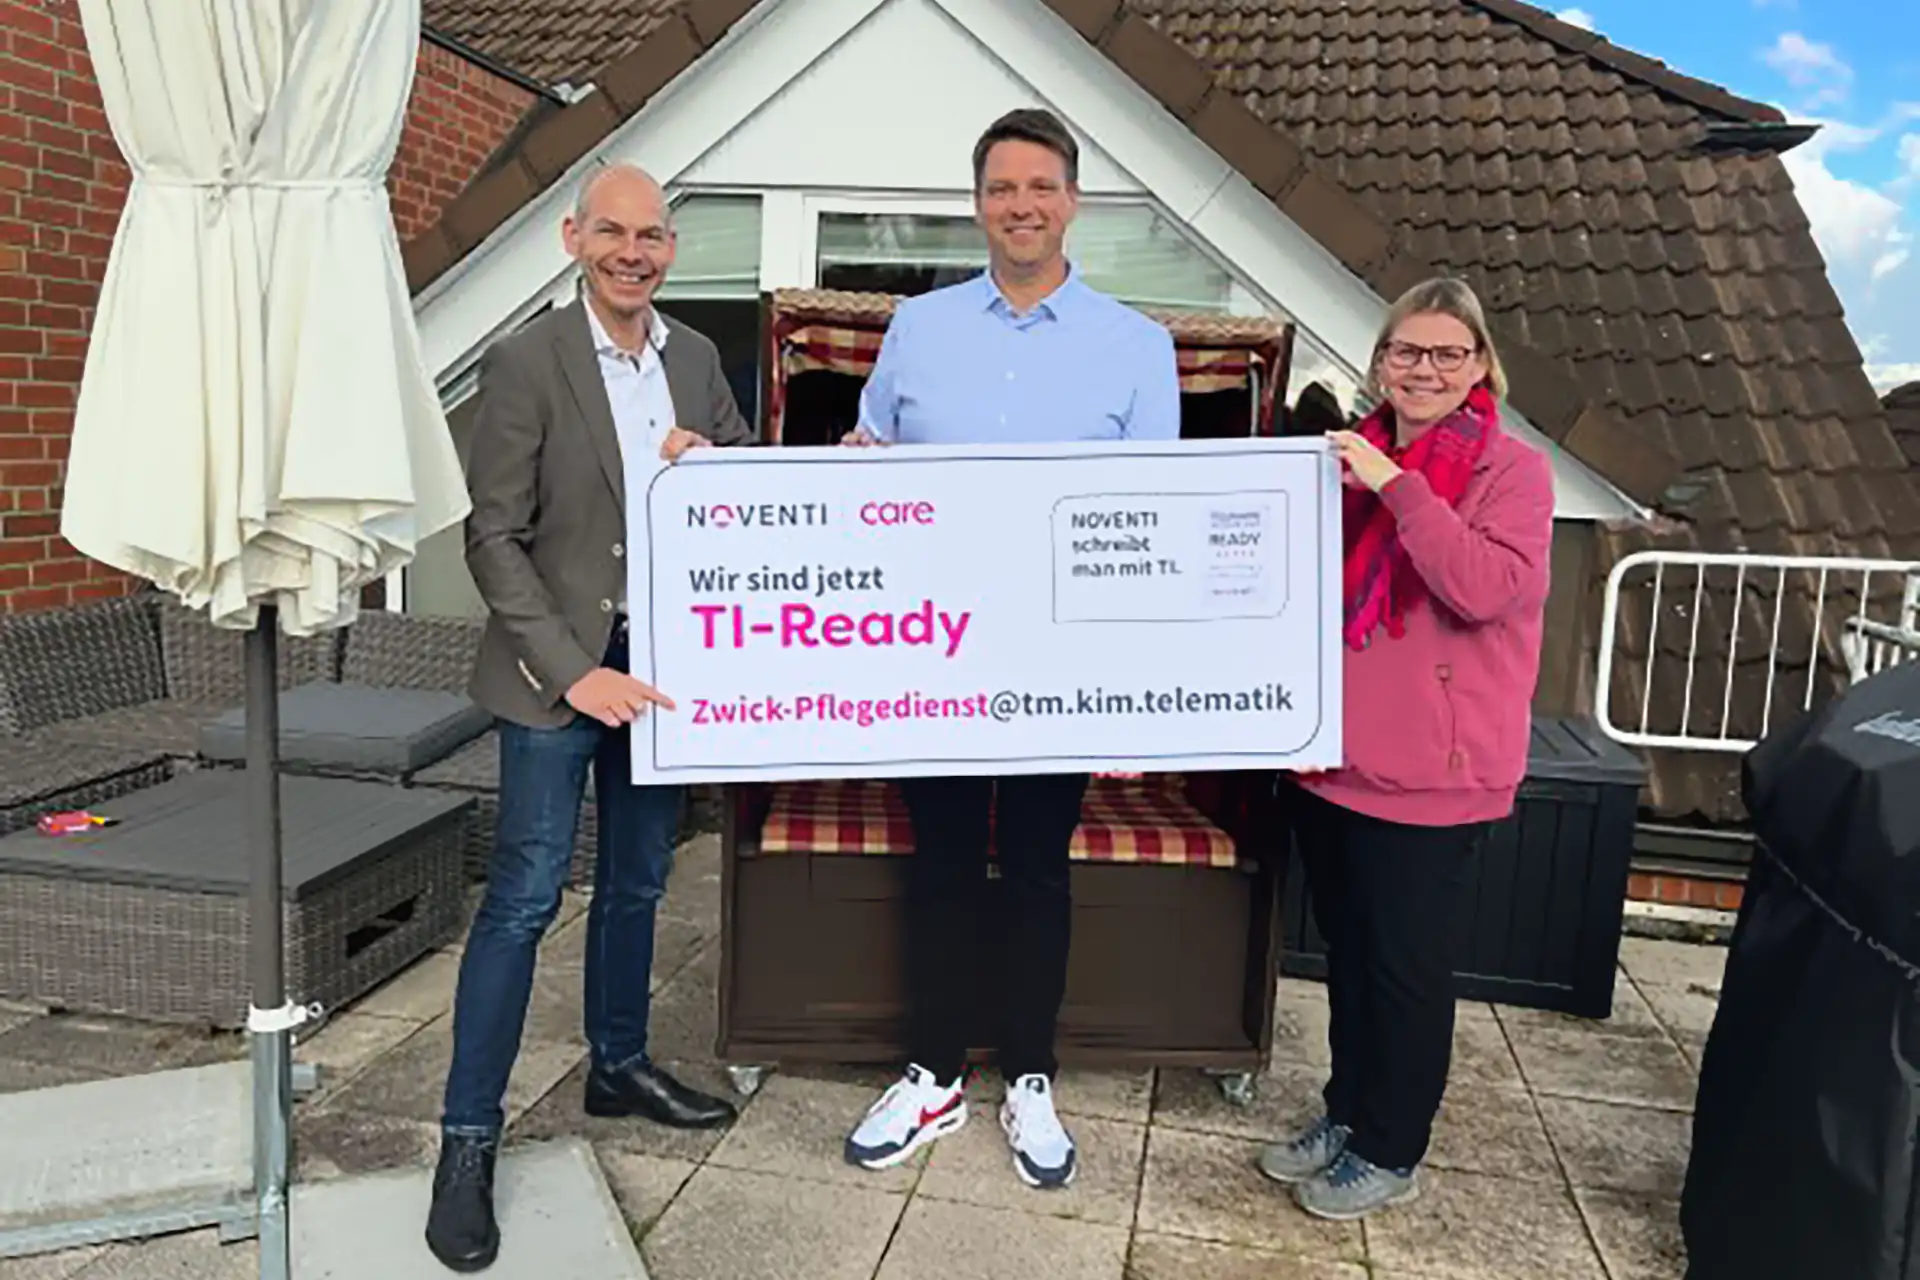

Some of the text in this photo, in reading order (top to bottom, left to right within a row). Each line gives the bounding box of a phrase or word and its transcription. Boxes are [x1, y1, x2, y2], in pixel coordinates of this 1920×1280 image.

[687, 501, 936, 528] NOVENTI care
[1071, 510, 1158, 529] NOVENTI
[688, 564, 884, 597] Wir sind jetzt
[1119, 558, 1152, 576] mit
[690, 598, 972, 658] TI-Ready
[691, 684, 1294, 728] Zwick-Pflegedienst@tm.kim.telematik
